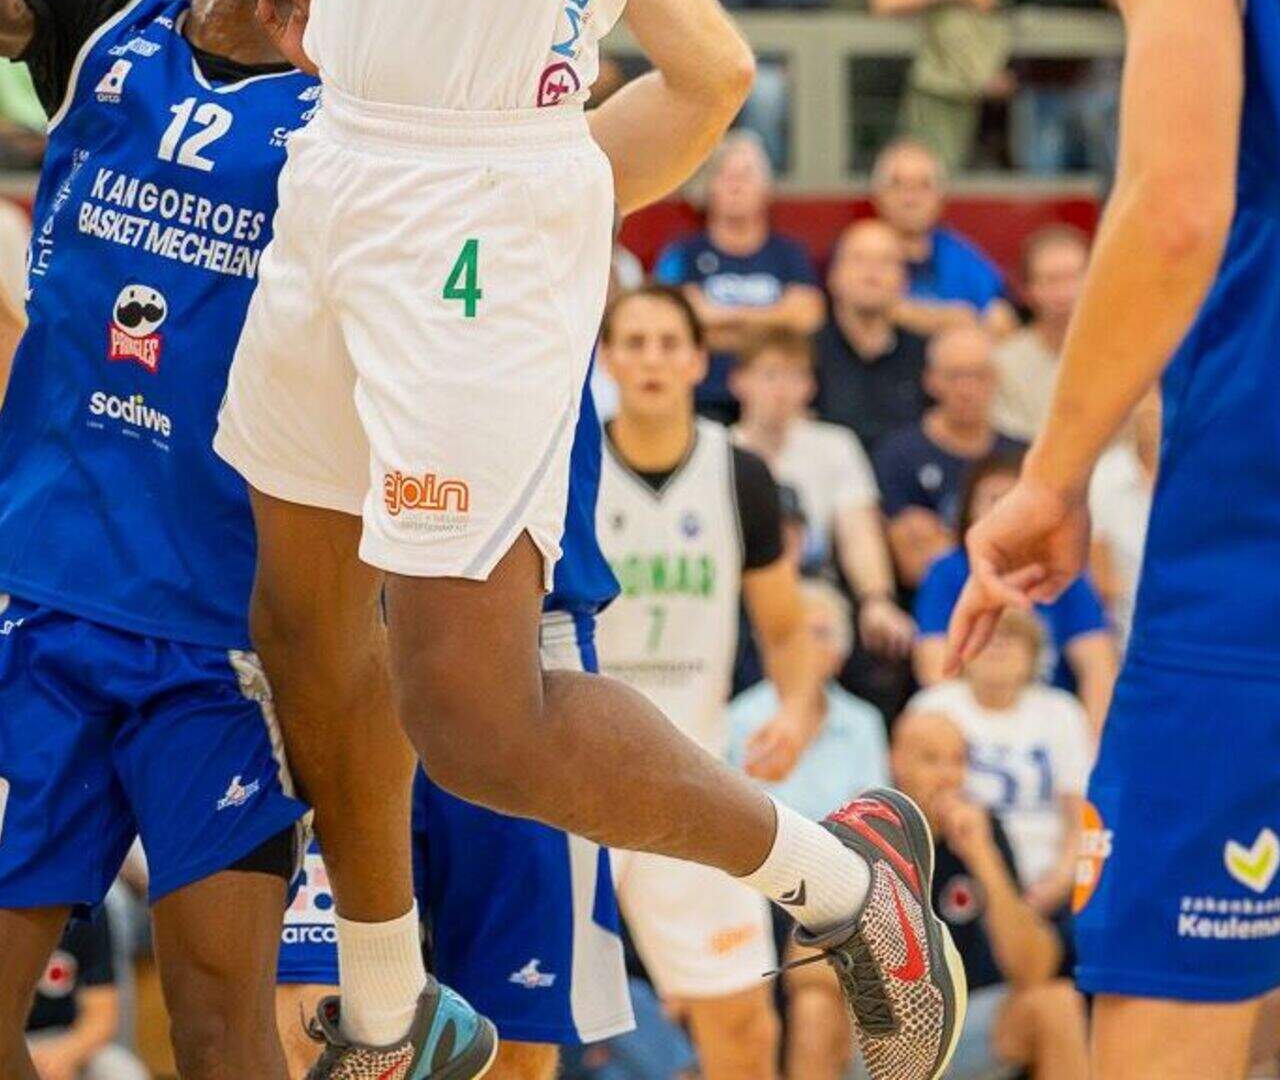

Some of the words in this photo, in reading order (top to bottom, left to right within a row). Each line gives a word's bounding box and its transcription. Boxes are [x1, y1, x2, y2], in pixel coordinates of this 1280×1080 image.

[157, 96, 234, 172] 12
[78, 201, 151, 248] BASKET
[144, 222, 260, 280] MECHELEN
[90, 167, 266, 242] KANGOEROES
[442, 238, 484, 318] 4
[88, 390, 172, 438] sodiwe
[614, 553, 716, 598] ONAR
[281, 926, 338, 944] arco
